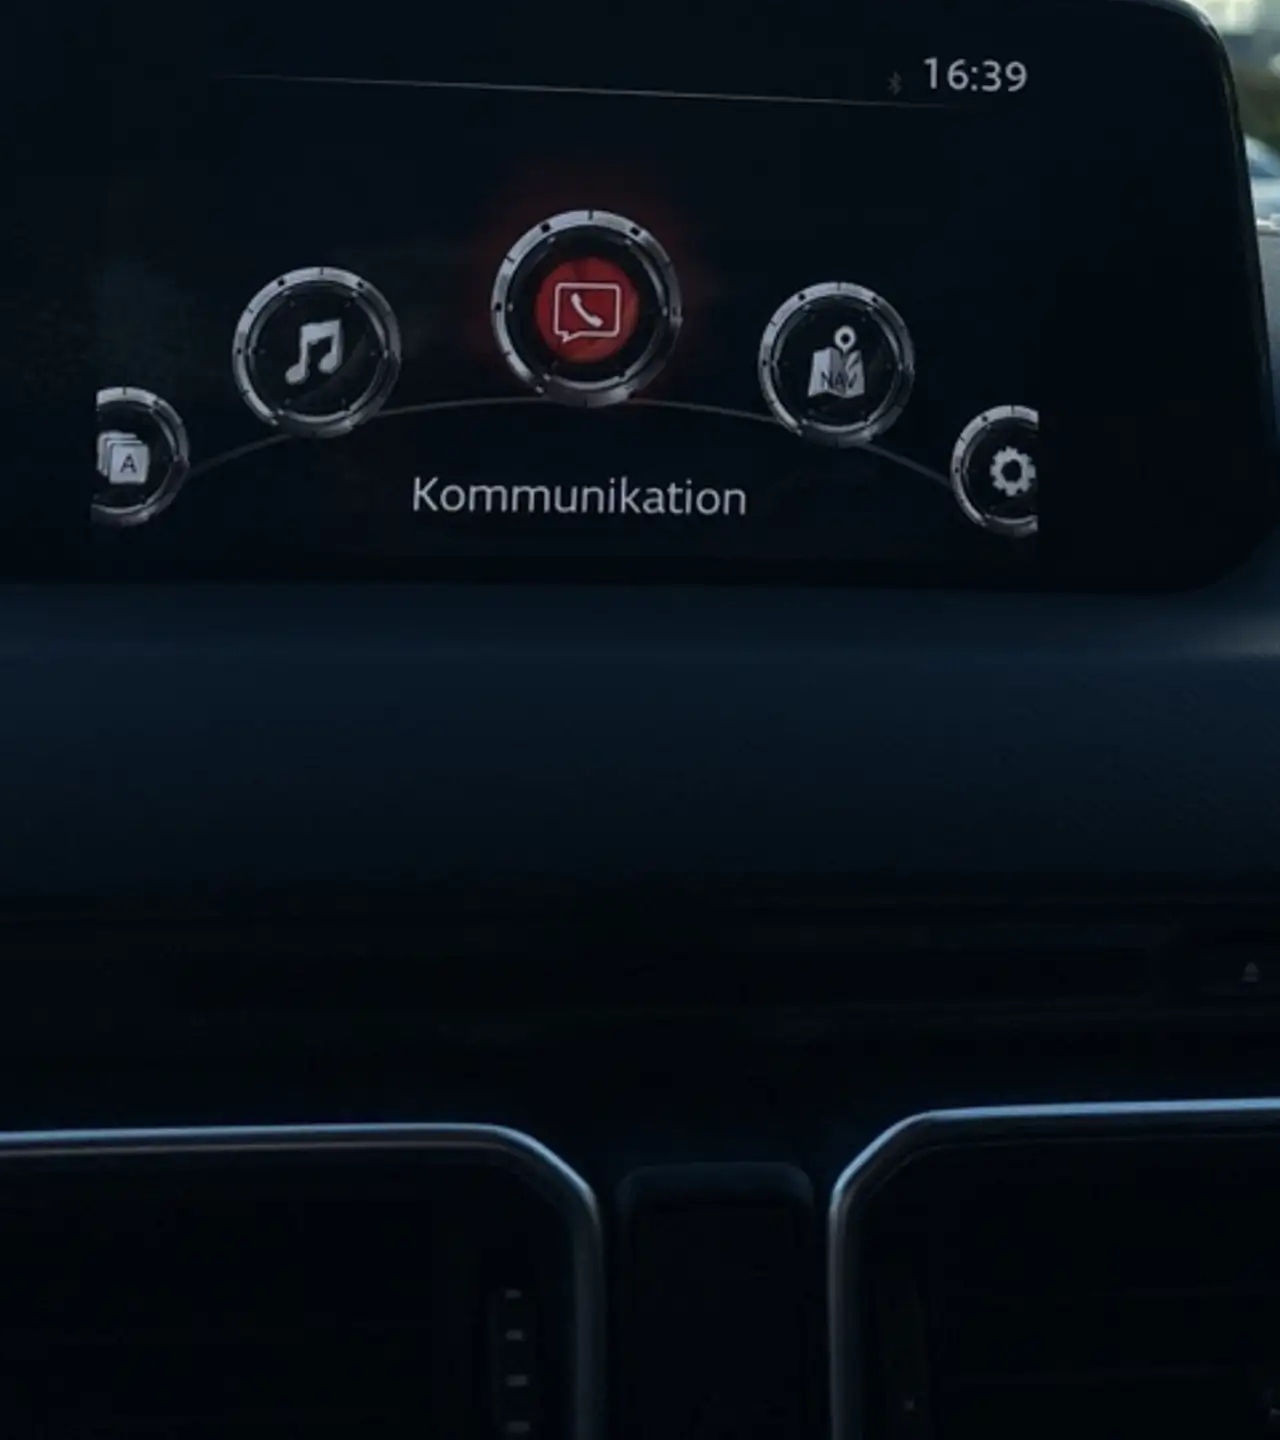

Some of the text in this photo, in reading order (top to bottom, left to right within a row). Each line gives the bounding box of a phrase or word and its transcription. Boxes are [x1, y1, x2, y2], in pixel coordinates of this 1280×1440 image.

[923, 56, 1028, 93] 16:39
[119, 453, 137, 474] A
[412, 476, 747, 516] Kommunikation
